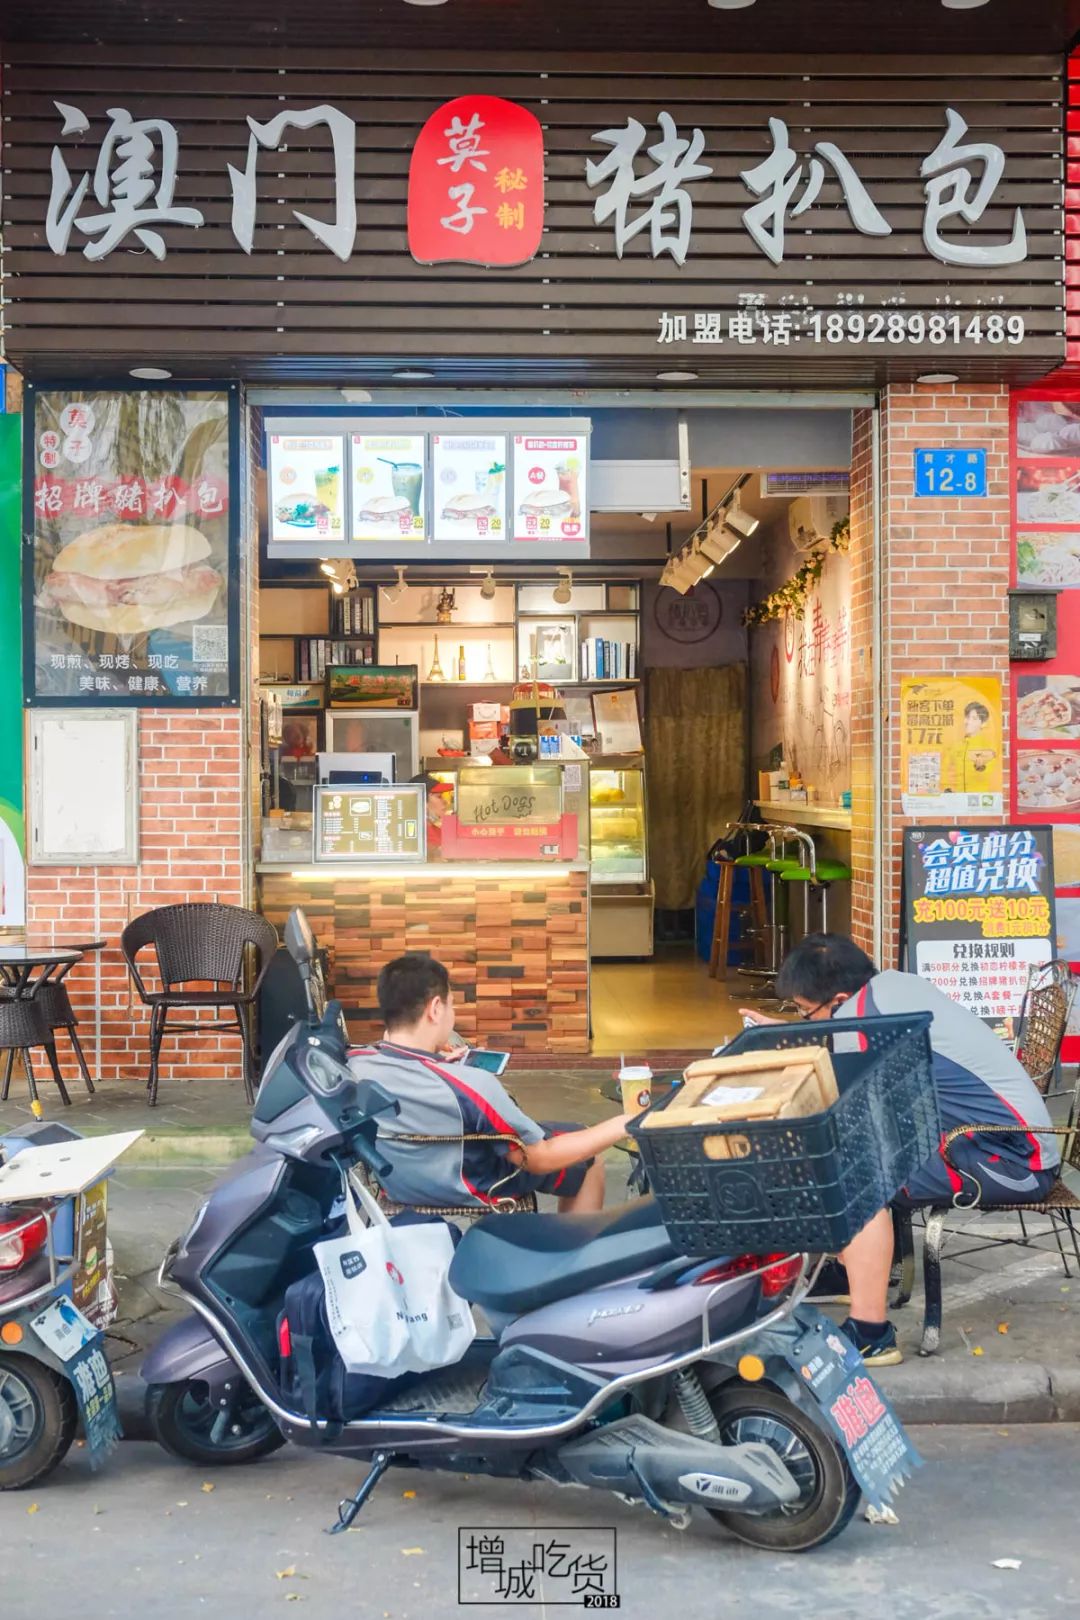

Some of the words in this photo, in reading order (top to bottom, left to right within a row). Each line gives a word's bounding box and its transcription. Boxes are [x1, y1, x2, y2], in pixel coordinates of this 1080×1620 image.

[46, 101, 357, 263] 澳门
[586, 108, 1028, 267] 猪扒包
[436, 112, 491, 235] 莫子
[493, 166, 528, 230] 秘制
[925, 468, 977, 492] 12-8
[50, 654, 179, 670] 现煎、现烤、现吃
[79, 675, 208, 692] 美味、健康、营养
[907, 728, 943, 744] 17元
[474, 800, 499, 823] Hot
[501, 794, 537, 813] Dogs
[923, 831, 1035, 868] 会员积分
[924, 857, 1040, 895] 超值兑换
[915, 898, 1049, 921] 充100元送10元
[953, 943, 1015, 958] 兑换规则
[830, 1376, 886, 1448] 雅迪
